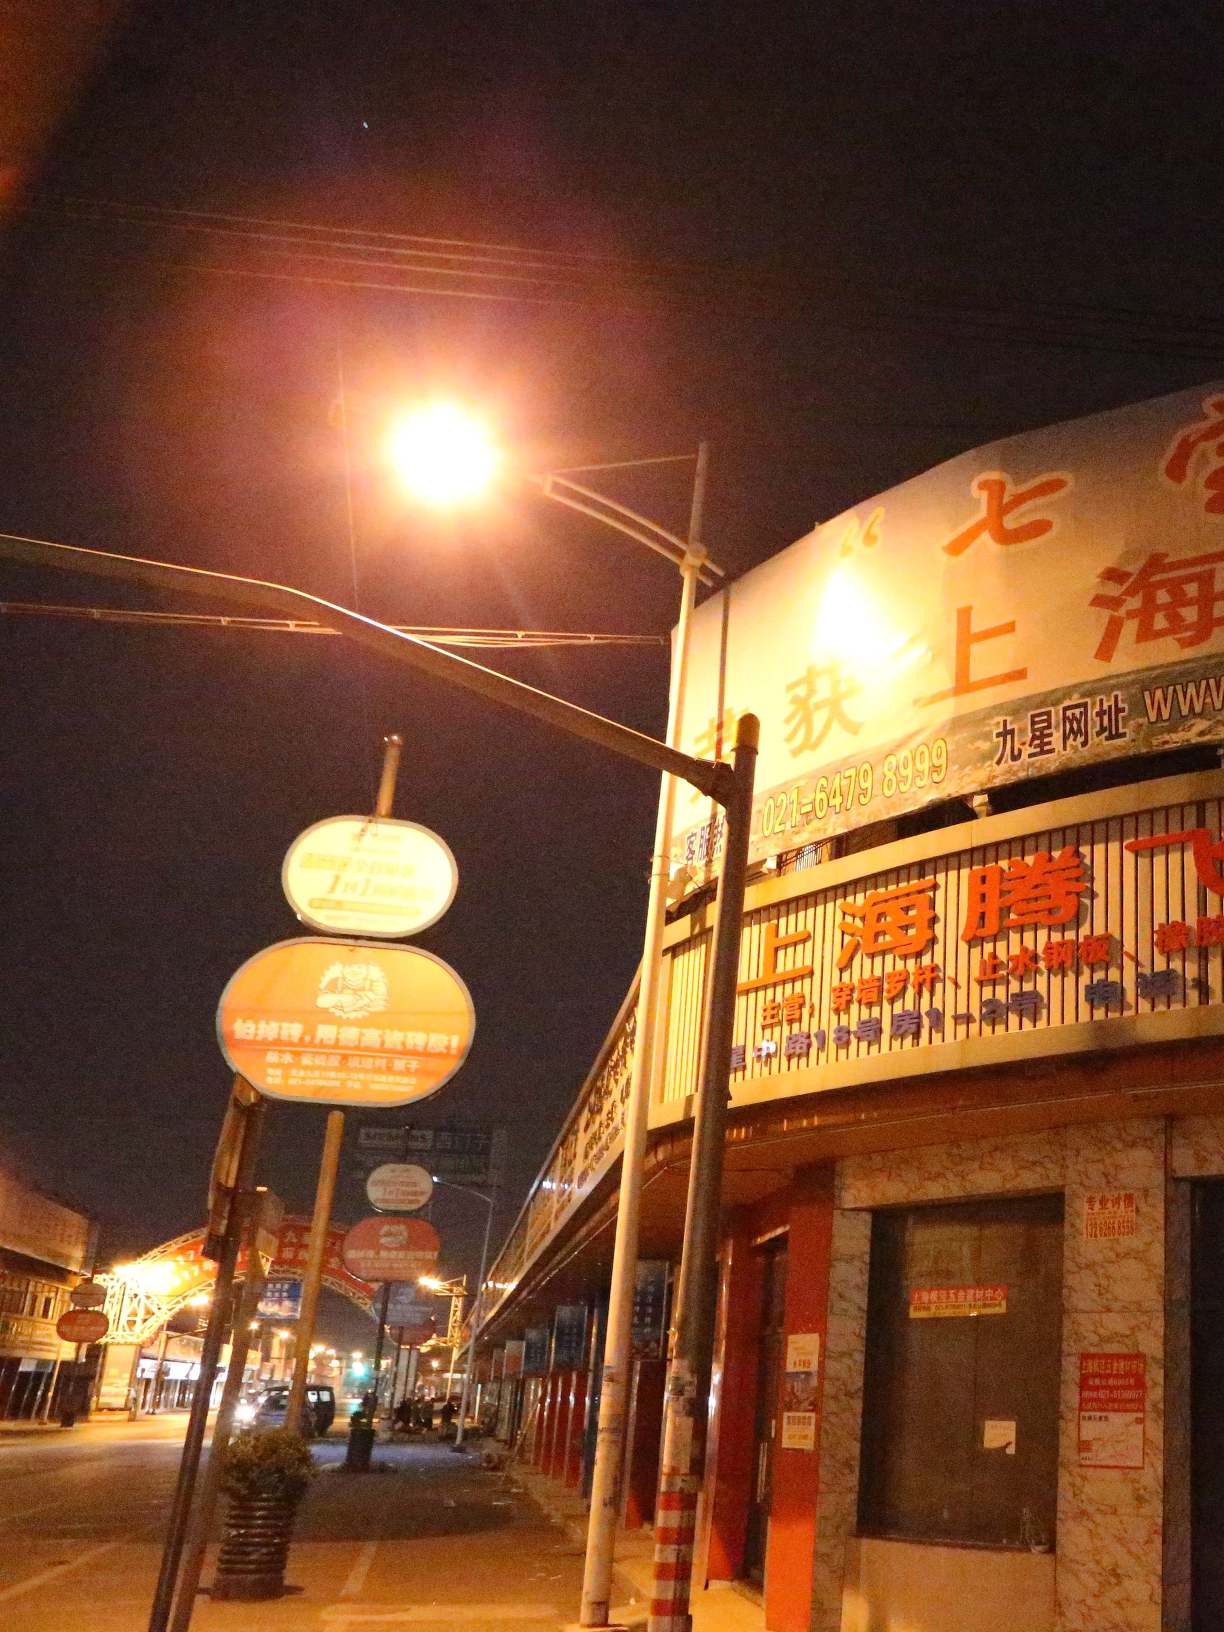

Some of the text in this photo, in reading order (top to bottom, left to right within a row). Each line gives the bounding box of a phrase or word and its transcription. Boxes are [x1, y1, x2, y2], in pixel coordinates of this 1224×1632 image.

[993, 692, 1128, 768] 九星网址
[762, 738, 949, 838] 021-6479 8999
